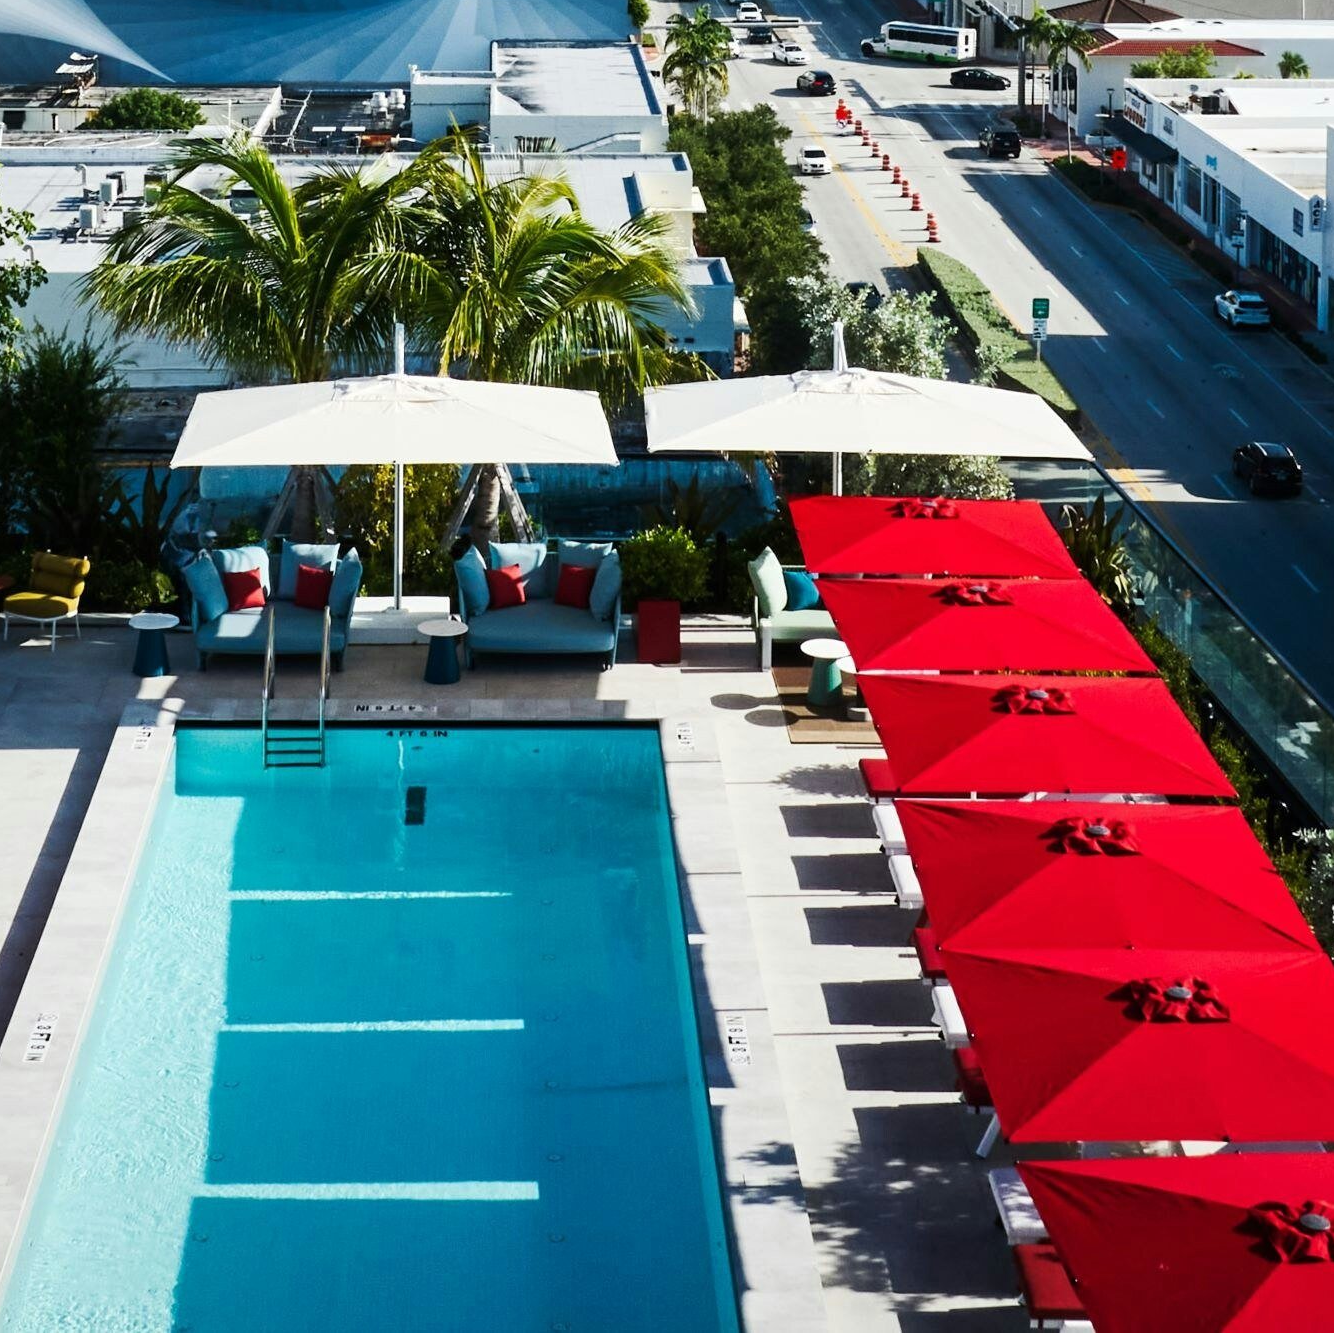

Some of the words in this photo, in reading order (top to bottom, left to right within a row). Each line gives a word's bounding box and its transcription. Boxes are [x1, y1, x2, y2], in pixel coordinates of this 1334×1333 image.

[1312, 200, 1321, 226] ACE
[30, 1032, 52, 1042] FT
[727, 1036, 748, 1045] FT
[24, 1052, 44, 1062] IN
